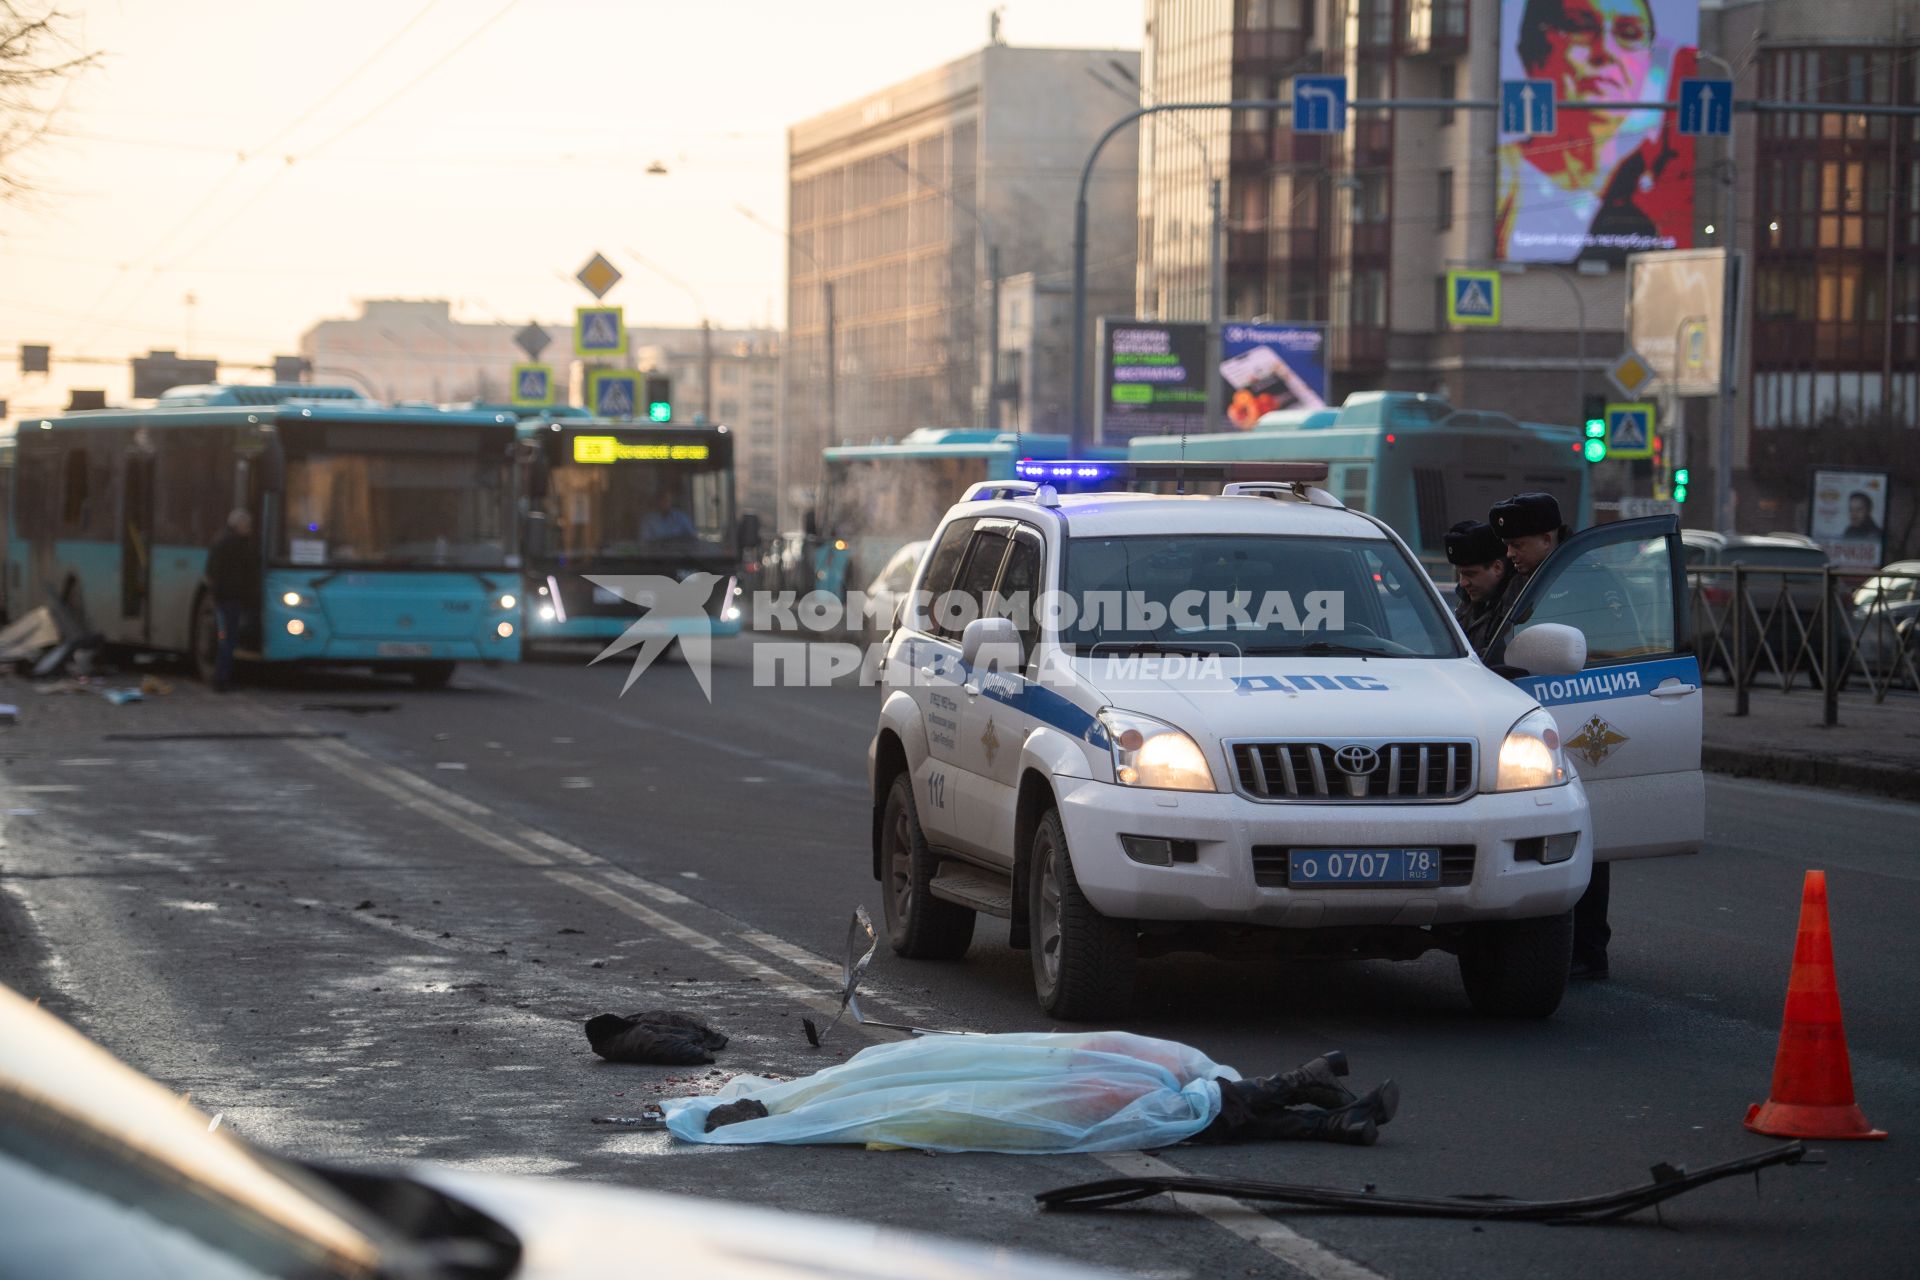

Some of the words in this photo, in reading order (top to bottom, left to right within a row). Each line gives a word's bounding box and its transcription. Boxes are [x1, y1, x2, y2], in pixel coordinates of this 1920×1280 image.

[983, 672, 1016, 700] ПОЛИЦИЯ
[1233, 674, 1389, 697] ДПС
[1533, 670, 1641, 702] ПОЛИЦИЯ
[928, 771, 945, 809] 112
[1328, 853, 1390, 878] 0707
[1406, 852, 1430, 870] 78
[1409, 871, 1427, 879] RUS
